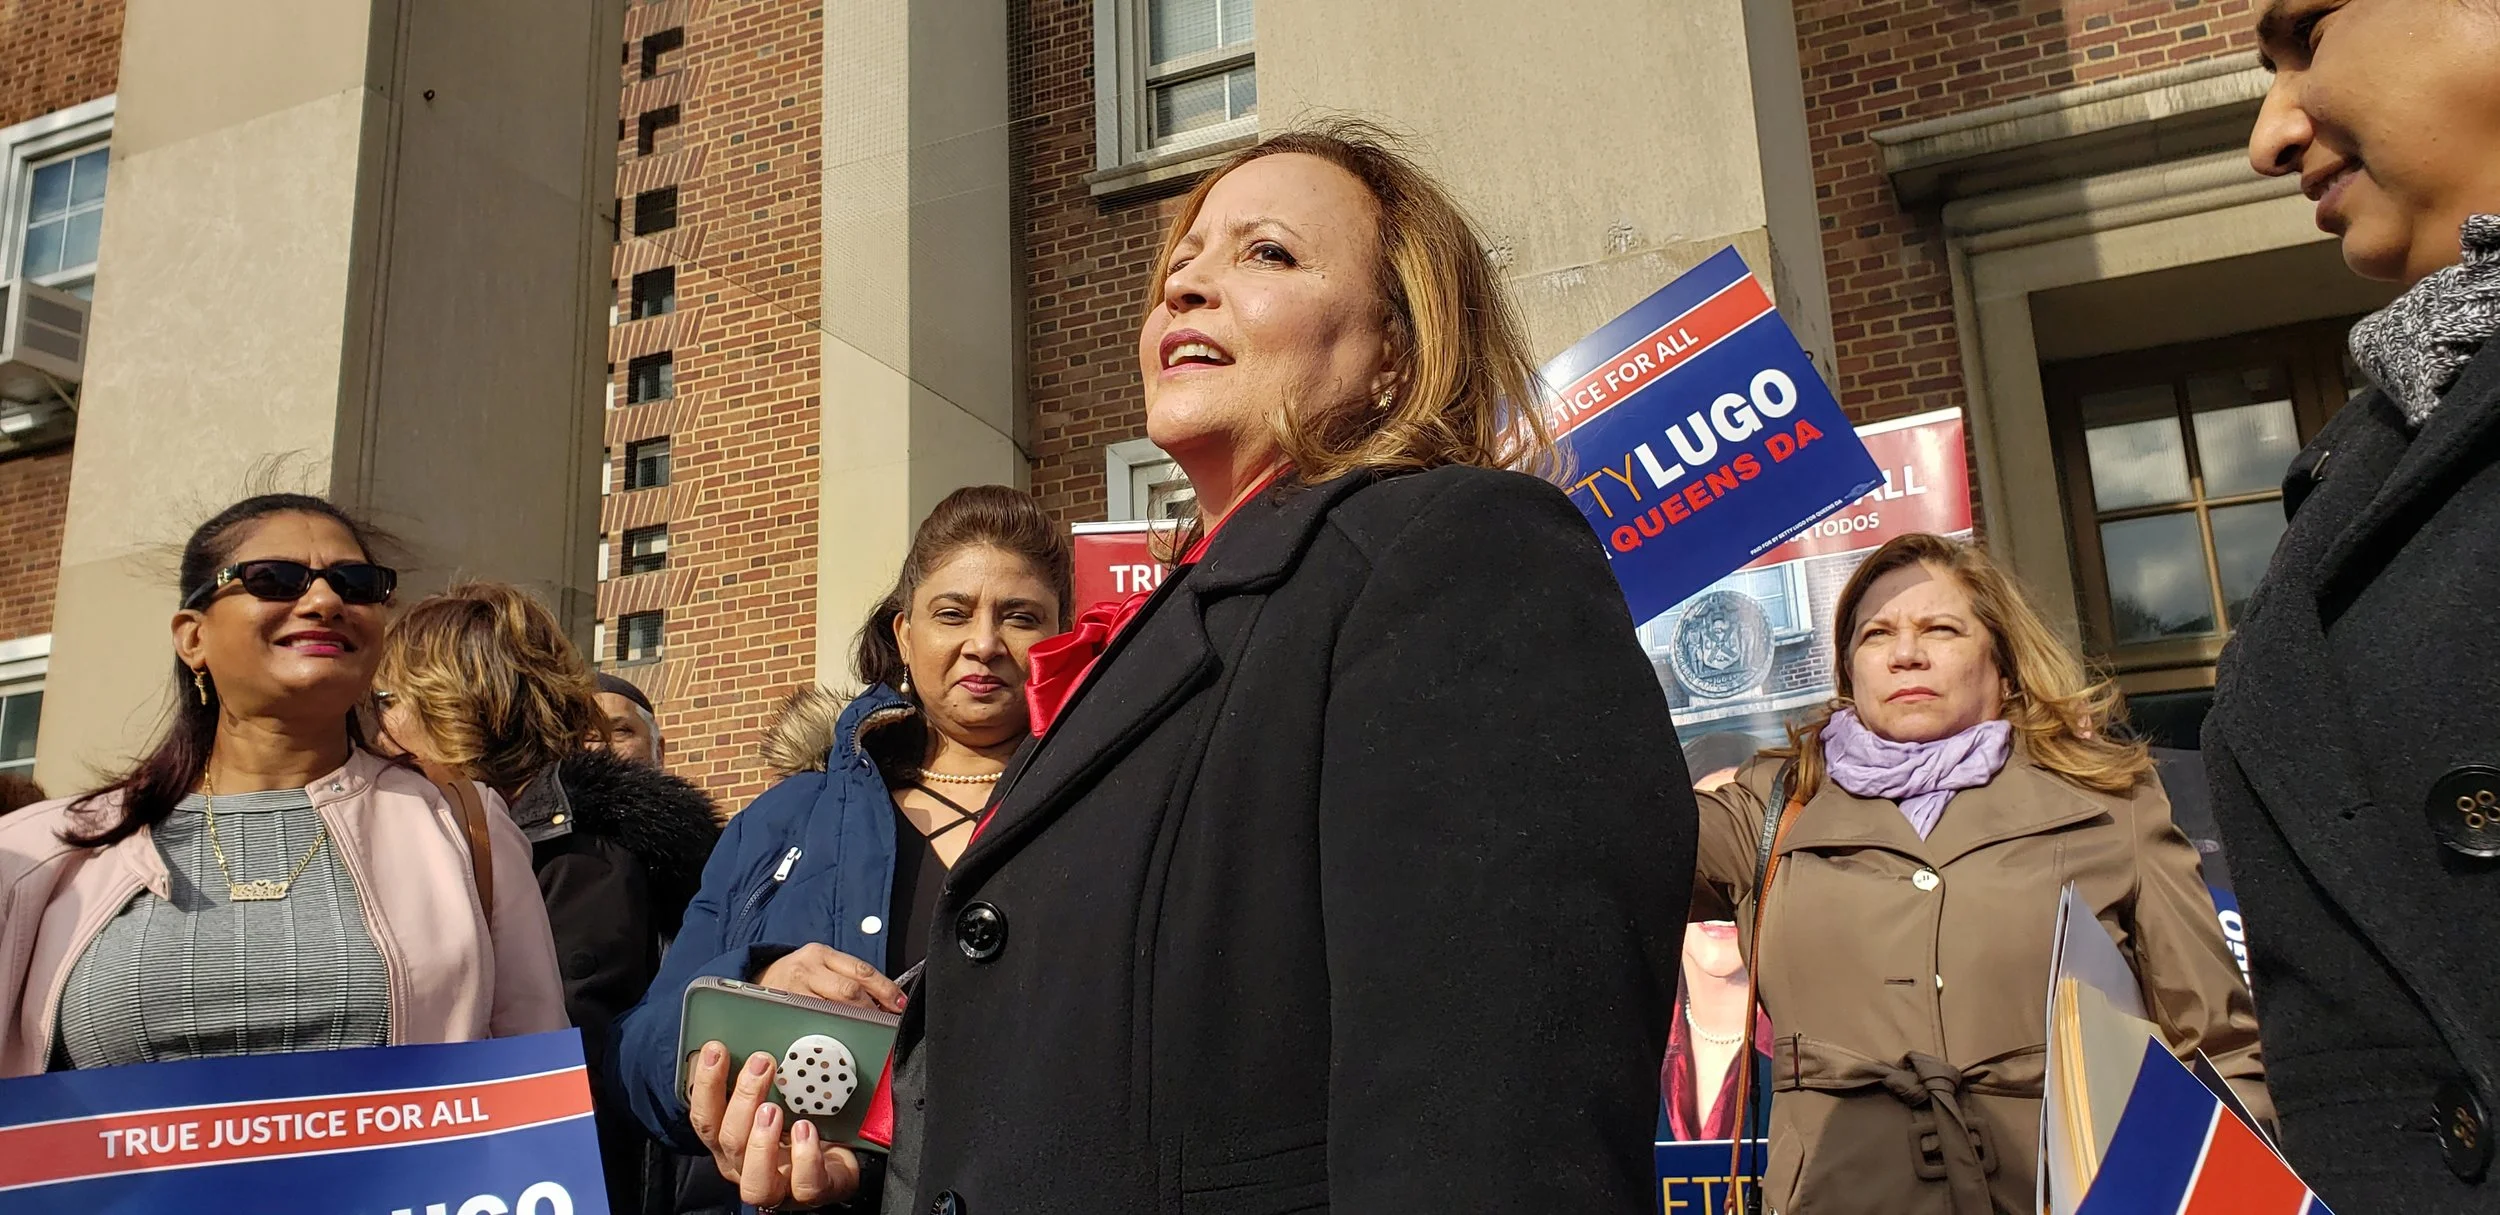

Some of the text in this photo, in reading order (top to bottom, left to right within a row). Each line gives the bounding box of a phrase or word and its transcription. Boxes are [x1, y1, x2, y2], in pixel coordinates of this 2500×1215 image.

[1604, 353, 1656, 392] FOR
[1656, 328, 1699, 363] ALL
[1634, 369, 1797, 489] LUGO
[1611, 419, 1824, 552] QUEENS DA
[1750, 545, 1763, 555] PAID
[1762, 539, 1773, 548] FOR
[1778, 527, 1794, 538] BETTY
[1793, 520, 1806, 530] LUGO
[1806, 514, 1816, 523] FOR
[1815, 504, 1835, 517] QUEENS
[1813, 512, 1880, 538] TODOS
[100, 1097, 489, 1159] TRUE JUSTICE FOR ALL
